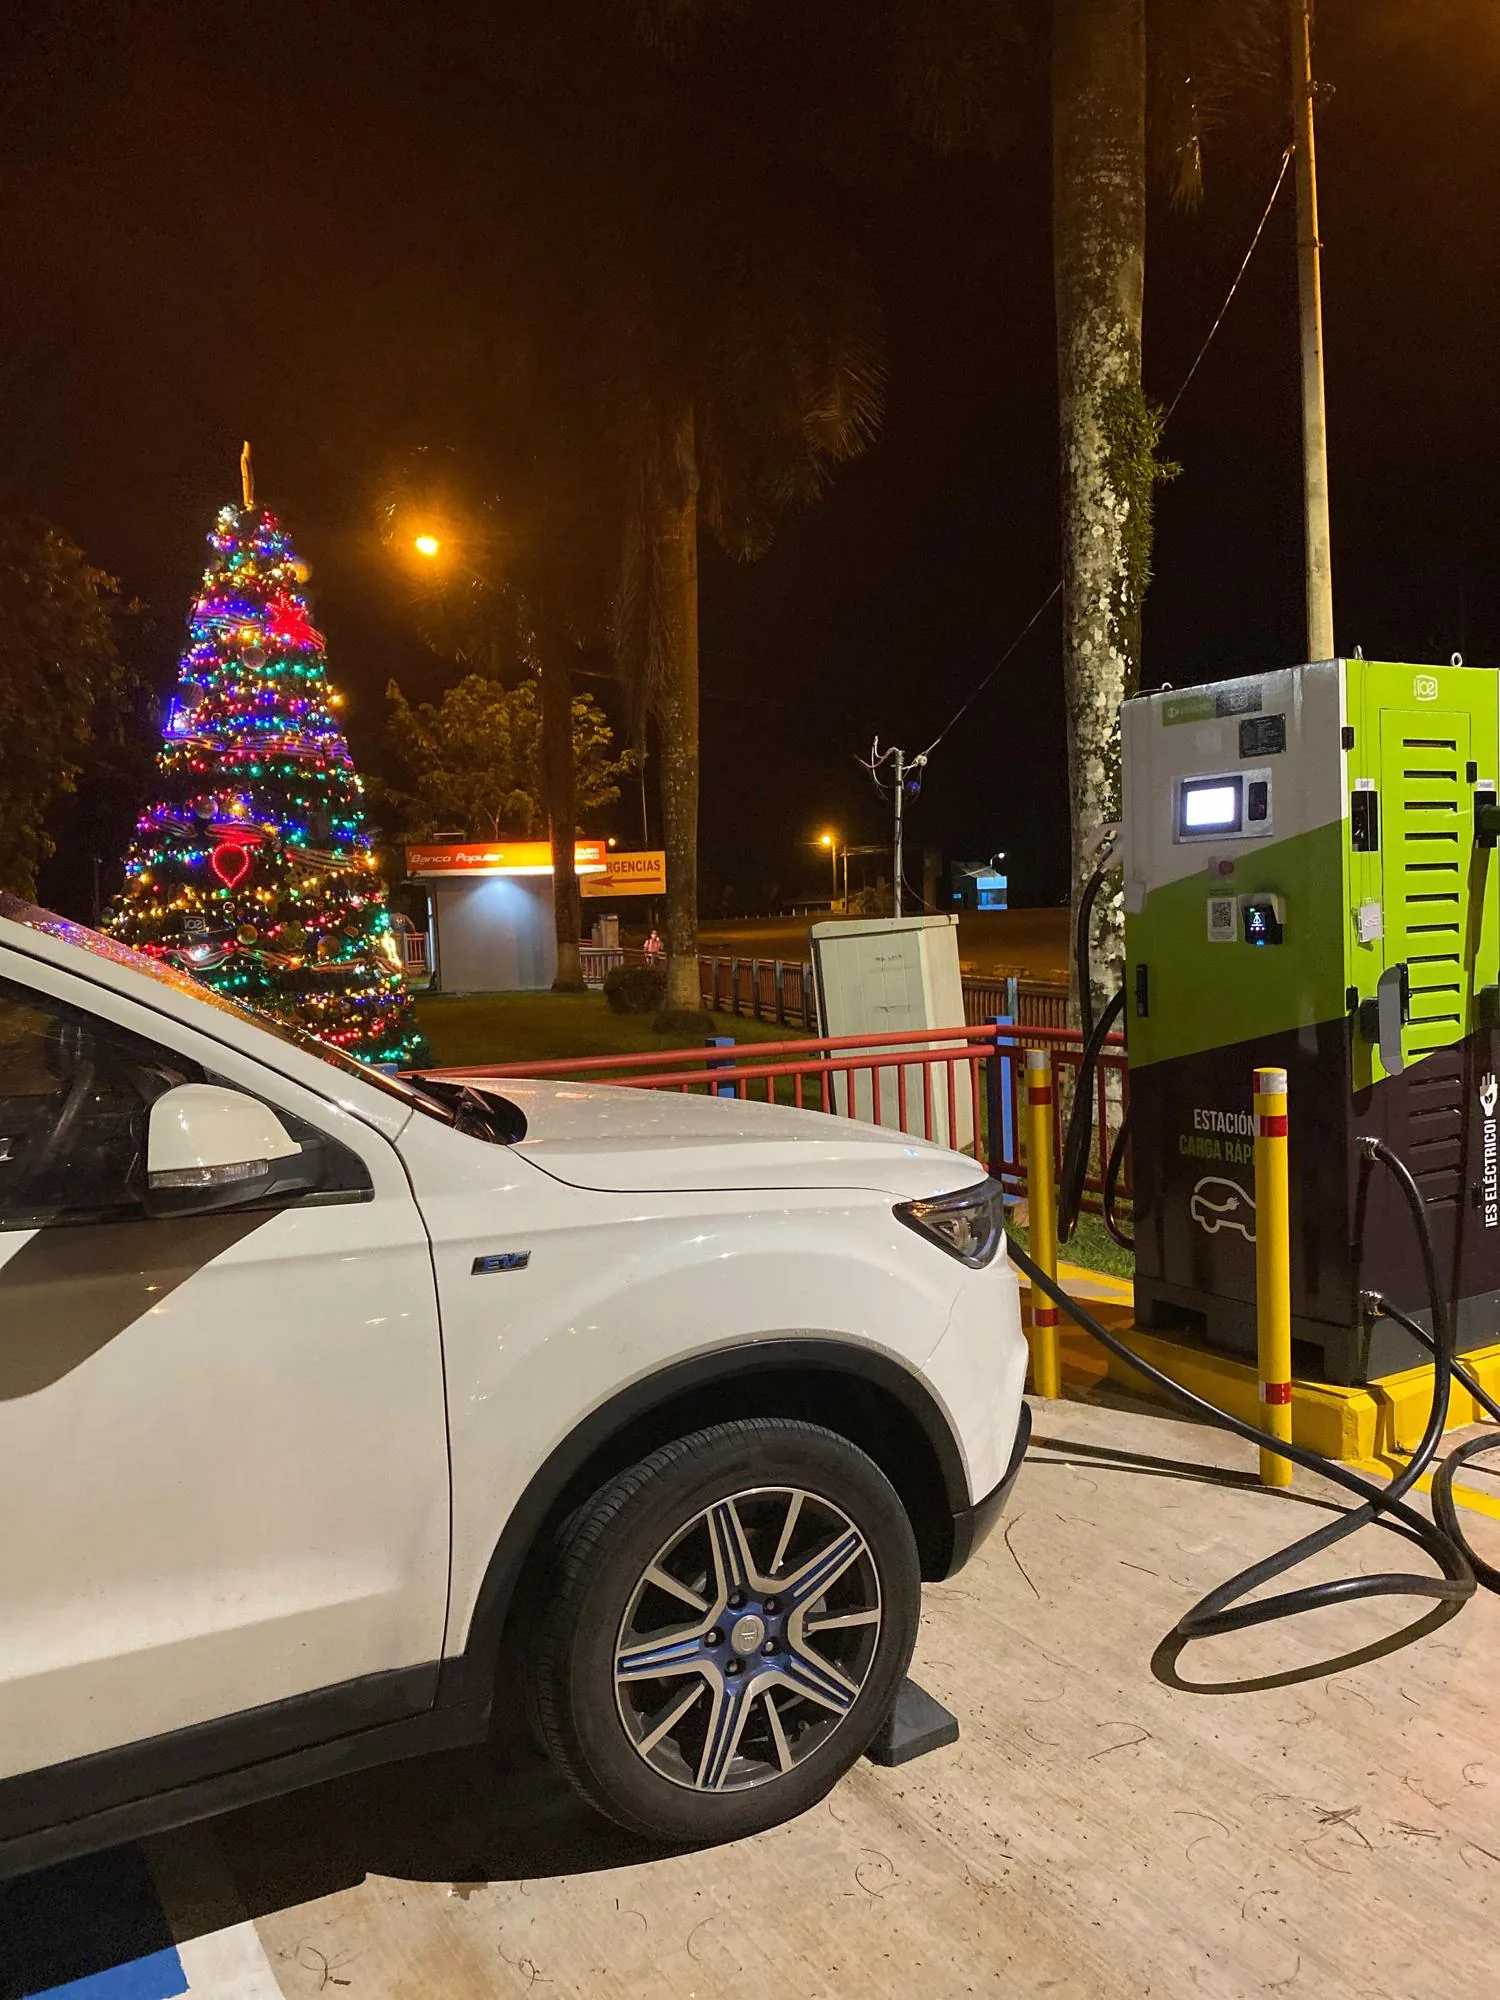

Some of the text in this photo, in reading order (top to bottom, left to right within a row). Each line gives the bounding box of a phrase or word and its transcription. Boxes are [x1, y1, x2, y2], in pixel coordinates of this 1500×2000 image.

[410, 852, 452, 864] Banco
[607, 860, 661, 873] RGENCIAS
[1194, 1109, 1257, 1136] ESTACIÓN
[1179, 1134, 1256, 1166] CARGA RÁPI
[483, 1252, 528, 1270] EV
